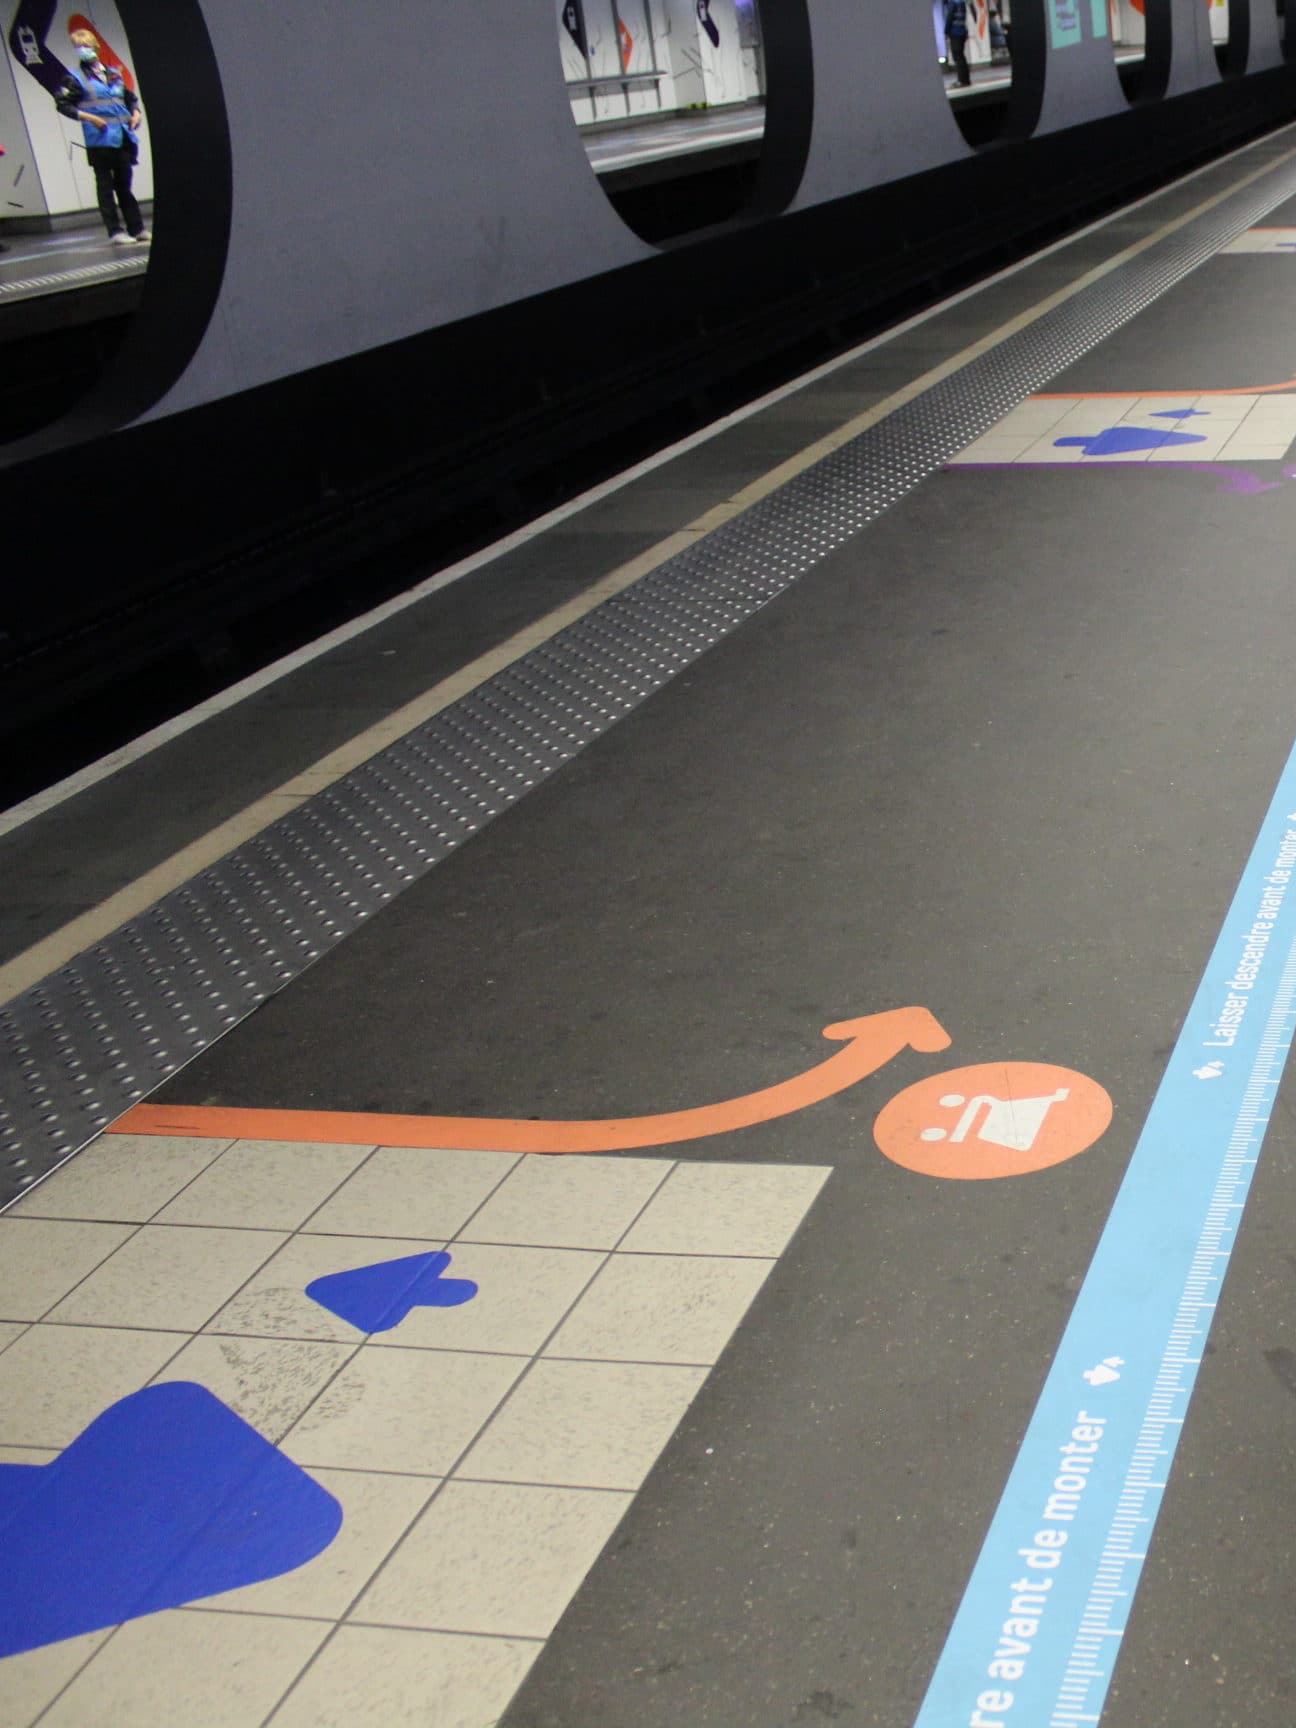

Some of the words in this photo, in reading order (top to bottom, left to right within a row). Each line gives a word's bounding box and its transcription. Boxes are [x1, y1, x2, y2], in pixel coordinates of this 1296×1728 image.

[1256, 885, 1286, 921] avant
[1263, 869, 1291, 885] de
[1224, 920, 1274, 991] descendre
[1202, 992, 1249, 1047] Laisser
[1042, 1410, 1108, 1520] monter
[1017, 1529, 1068, 1570] de
[988, 1577, 1053, 1681] avant
